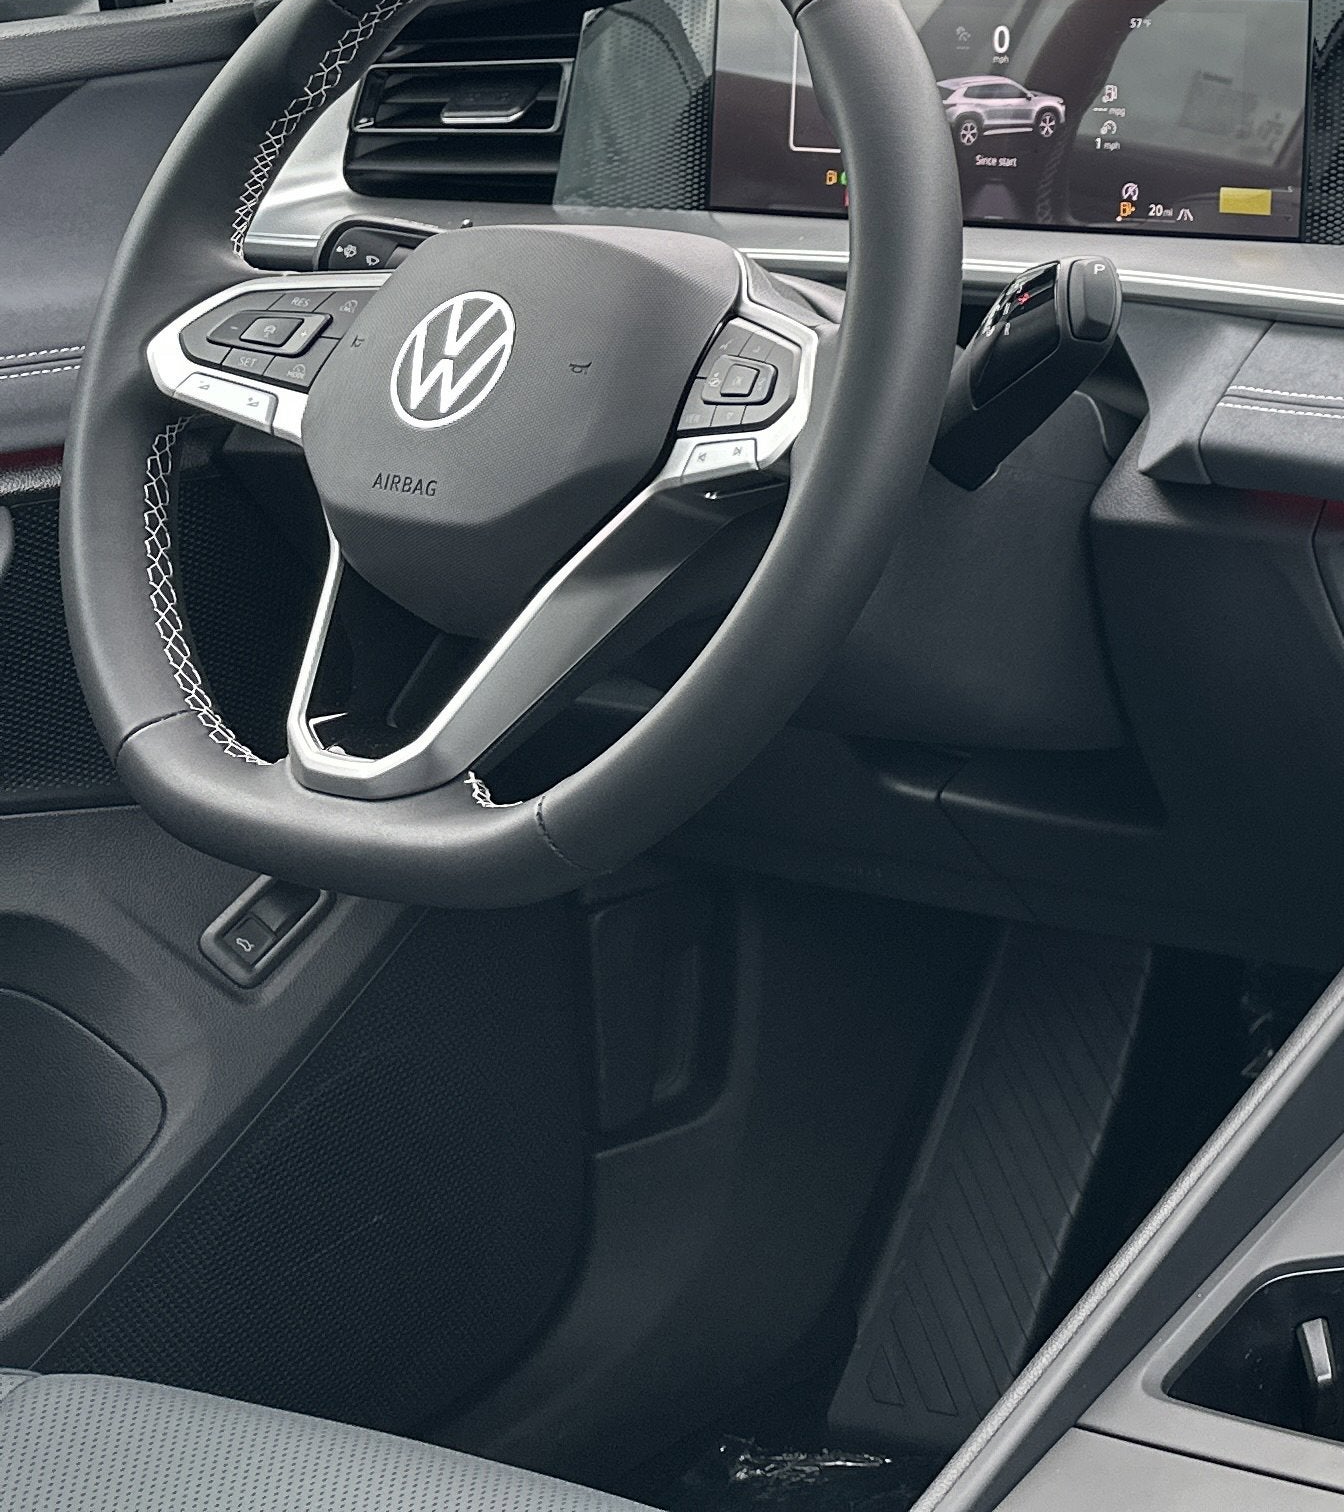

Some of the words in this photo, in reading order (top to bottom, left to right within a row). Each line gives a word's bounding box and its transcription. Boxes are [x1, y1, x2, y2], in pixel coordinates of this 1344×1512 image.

[1129, 17, 1142, 29] 57
[993, 25, 1011, 54] 0
[975, 154, 997, 167] Since
[998, 156, 1017, 167] start
[1094, 263, 1106, 275] P
[291, 296, 312, 308] RES
[237, 356, 258, 368] SET
[371, 472, 438, 497] AIRBAG
